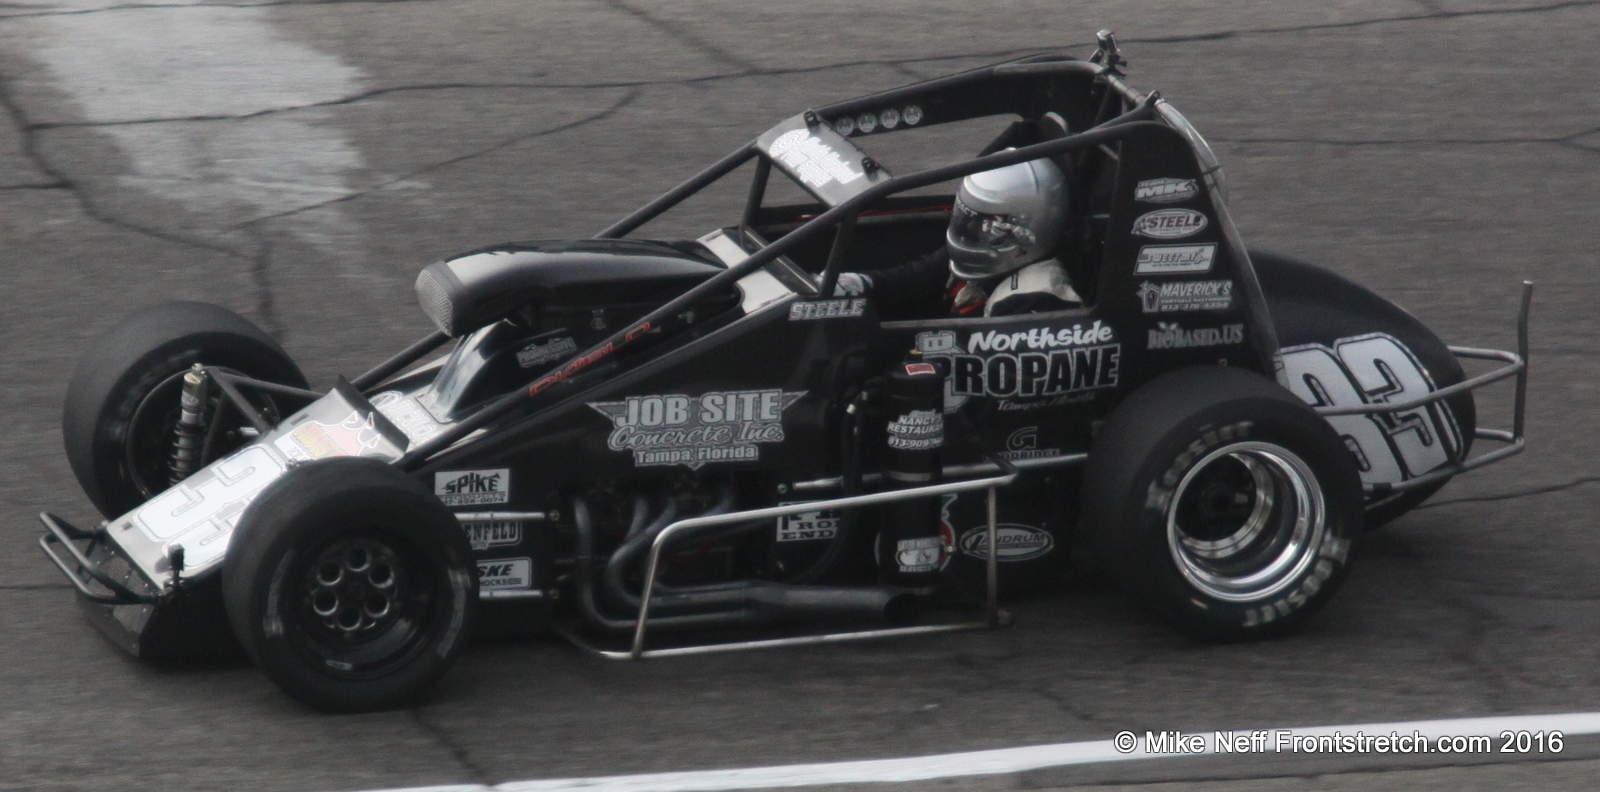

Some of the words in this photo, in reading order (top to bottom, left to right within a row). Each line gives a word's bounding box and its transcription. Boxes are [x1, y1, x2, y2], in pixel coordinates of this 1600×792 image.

[788, 299, 867, 321] STEELE
[968, 320, 1114, 354] Northside
[615, 396, 690, 428] JOB
[701, 391, 780, 423] SITE
[608, 426, 732, 450] Concrete
[739, 423, 785, 442] Inc.
[697, 446, 757, 461] Florida
[442, 472, 501, 494] SPIKE
[781, 530, 834, 540] END
